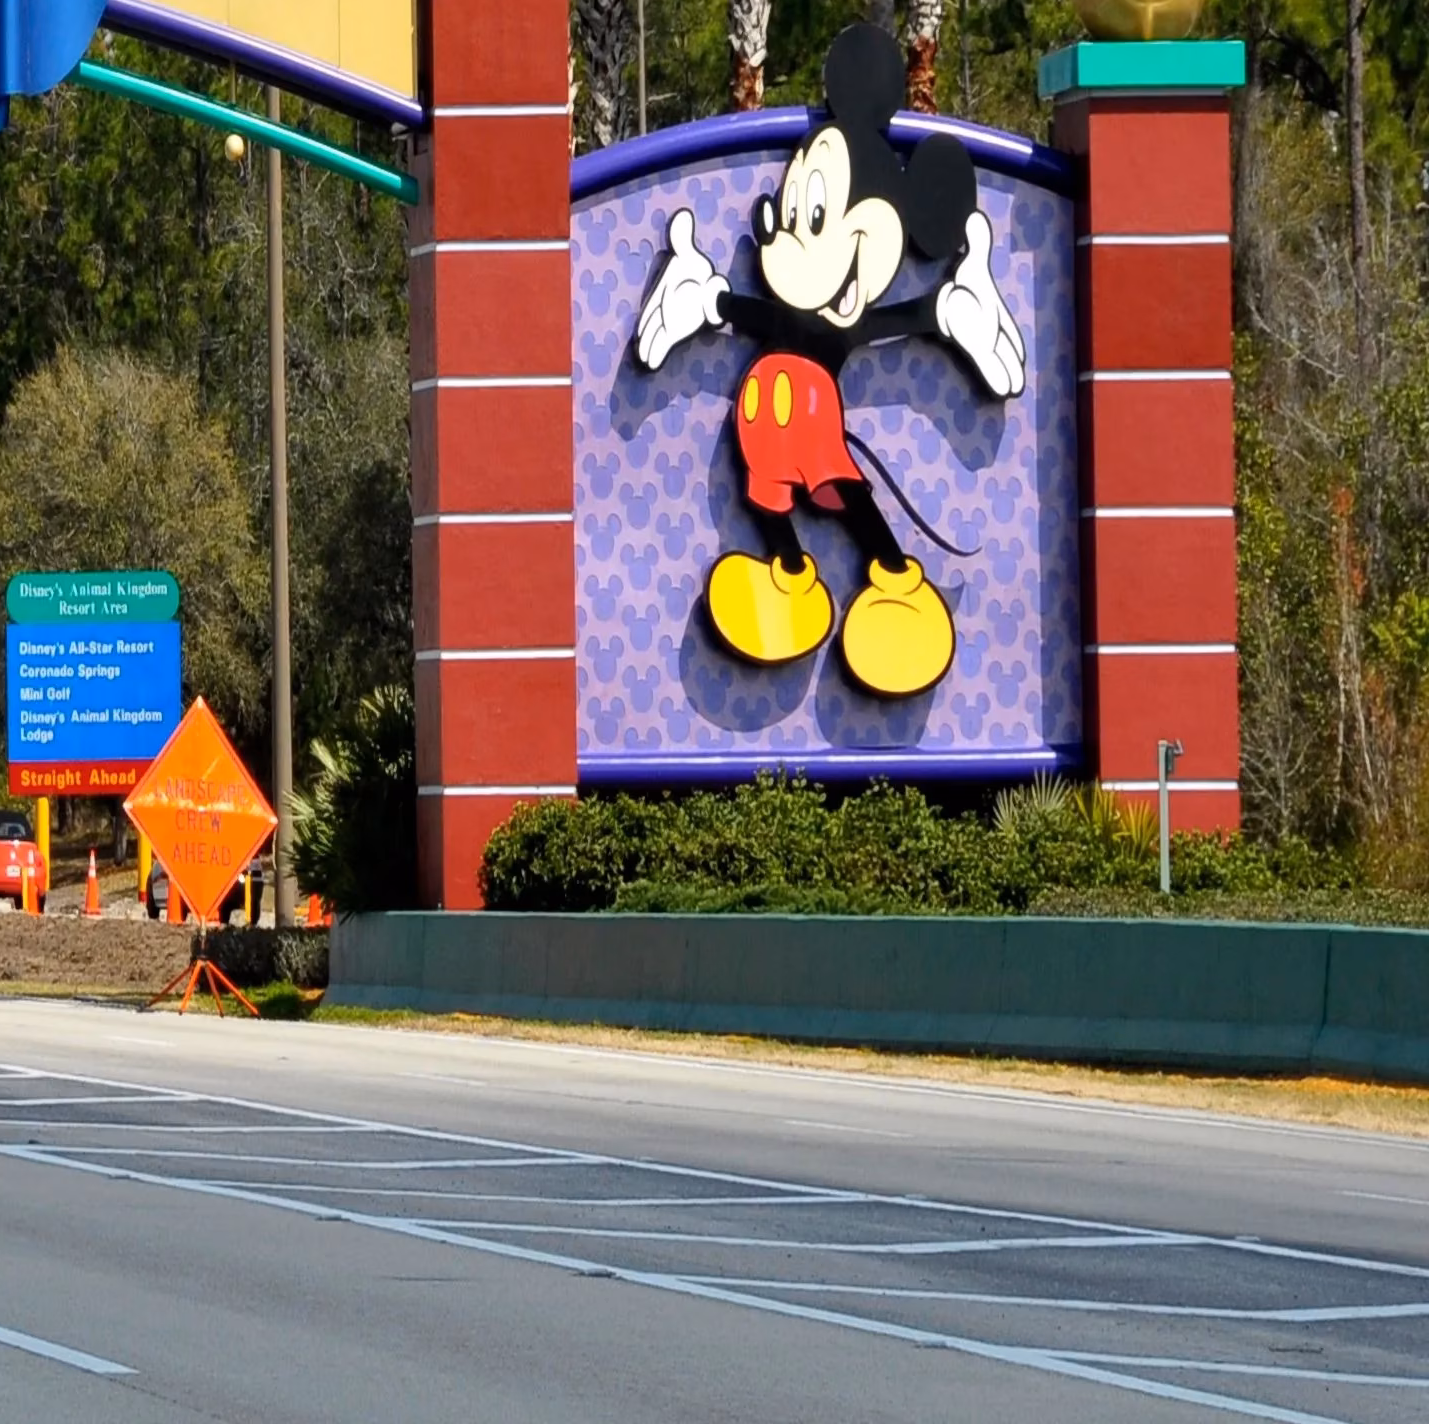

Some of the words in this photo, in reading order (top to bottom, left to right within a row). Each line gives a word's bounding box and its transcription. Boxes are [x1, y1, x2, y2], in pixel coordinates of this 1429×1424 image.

[20, 582, 63, 600] Disney's
[69, 582, 111, 597] Animal
[117, 581, 168, 598] Kingdom
[59, 600, 95, 615] Resort
[101, 600, 128, 615] Area
[19, 641, 65, 658] Disney's
[117, 640, 154, 653] Resort
[19, 664, 74, 678] Coronado
[78, 663, 121, 680] Springs
[20, 687, 43, 701] Mini
[47, 687, 71, 701] Golf
[20, 710, 65, 726] Disney's
[71, 709, 109, 723] Animal
[113, 708, 162, 724] Kingdom
[21, 727, 54, 744] Lodge
[21, 769, 81, 790] Straight
[89, 768, 136, 785] Ahead
[175, 808, 222, 833] CREW
[173, 841, 232, 867] AHEAD
